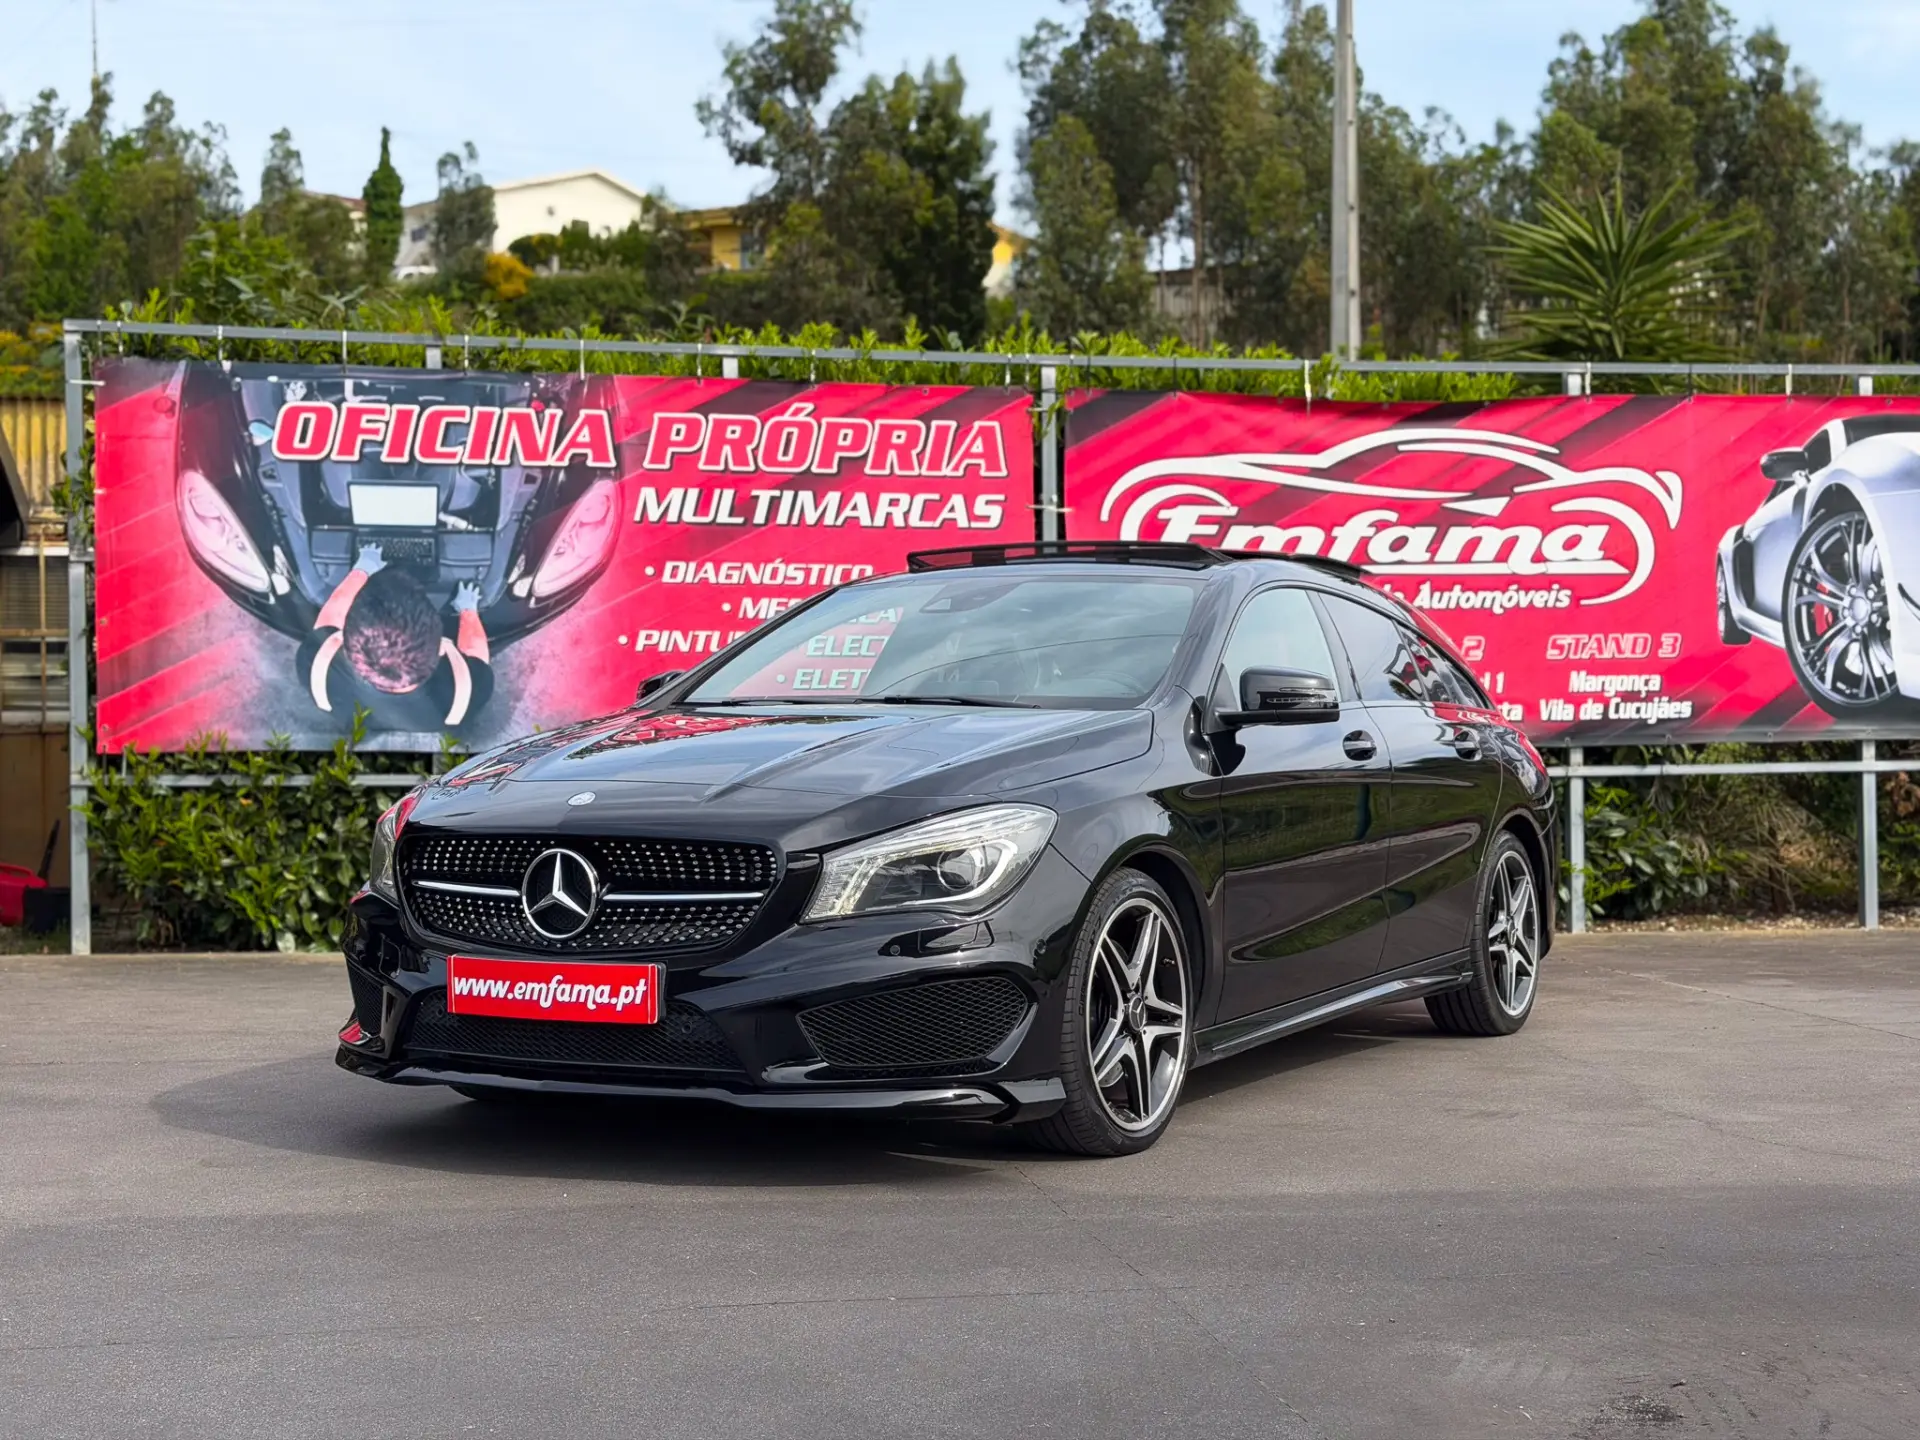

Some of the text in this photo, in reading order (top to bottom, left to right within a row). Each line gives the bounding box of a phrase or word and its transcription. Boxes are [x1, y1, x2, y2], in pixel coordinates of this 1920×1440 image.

[272, 401, 1008, 477] OFICINA PRÓPRIA
[634, 486, 1005, 528] MULTIMARCAS
[1157, 504, 1611, 575] Emfama
[661, 558, 874, 586] DIAGNÓSTICO
[1413, 580, 1572, 614] Automóveis
[1461, 635, 1486, 661] 2
[1546, 633, 1682, 660] STAND 3
[1568, 670, 1662, 698] Margonça
[1539, 696, 1693, 724] Vila de Cucujães
[454, 975, 647, 1012] www.emfama.pt
